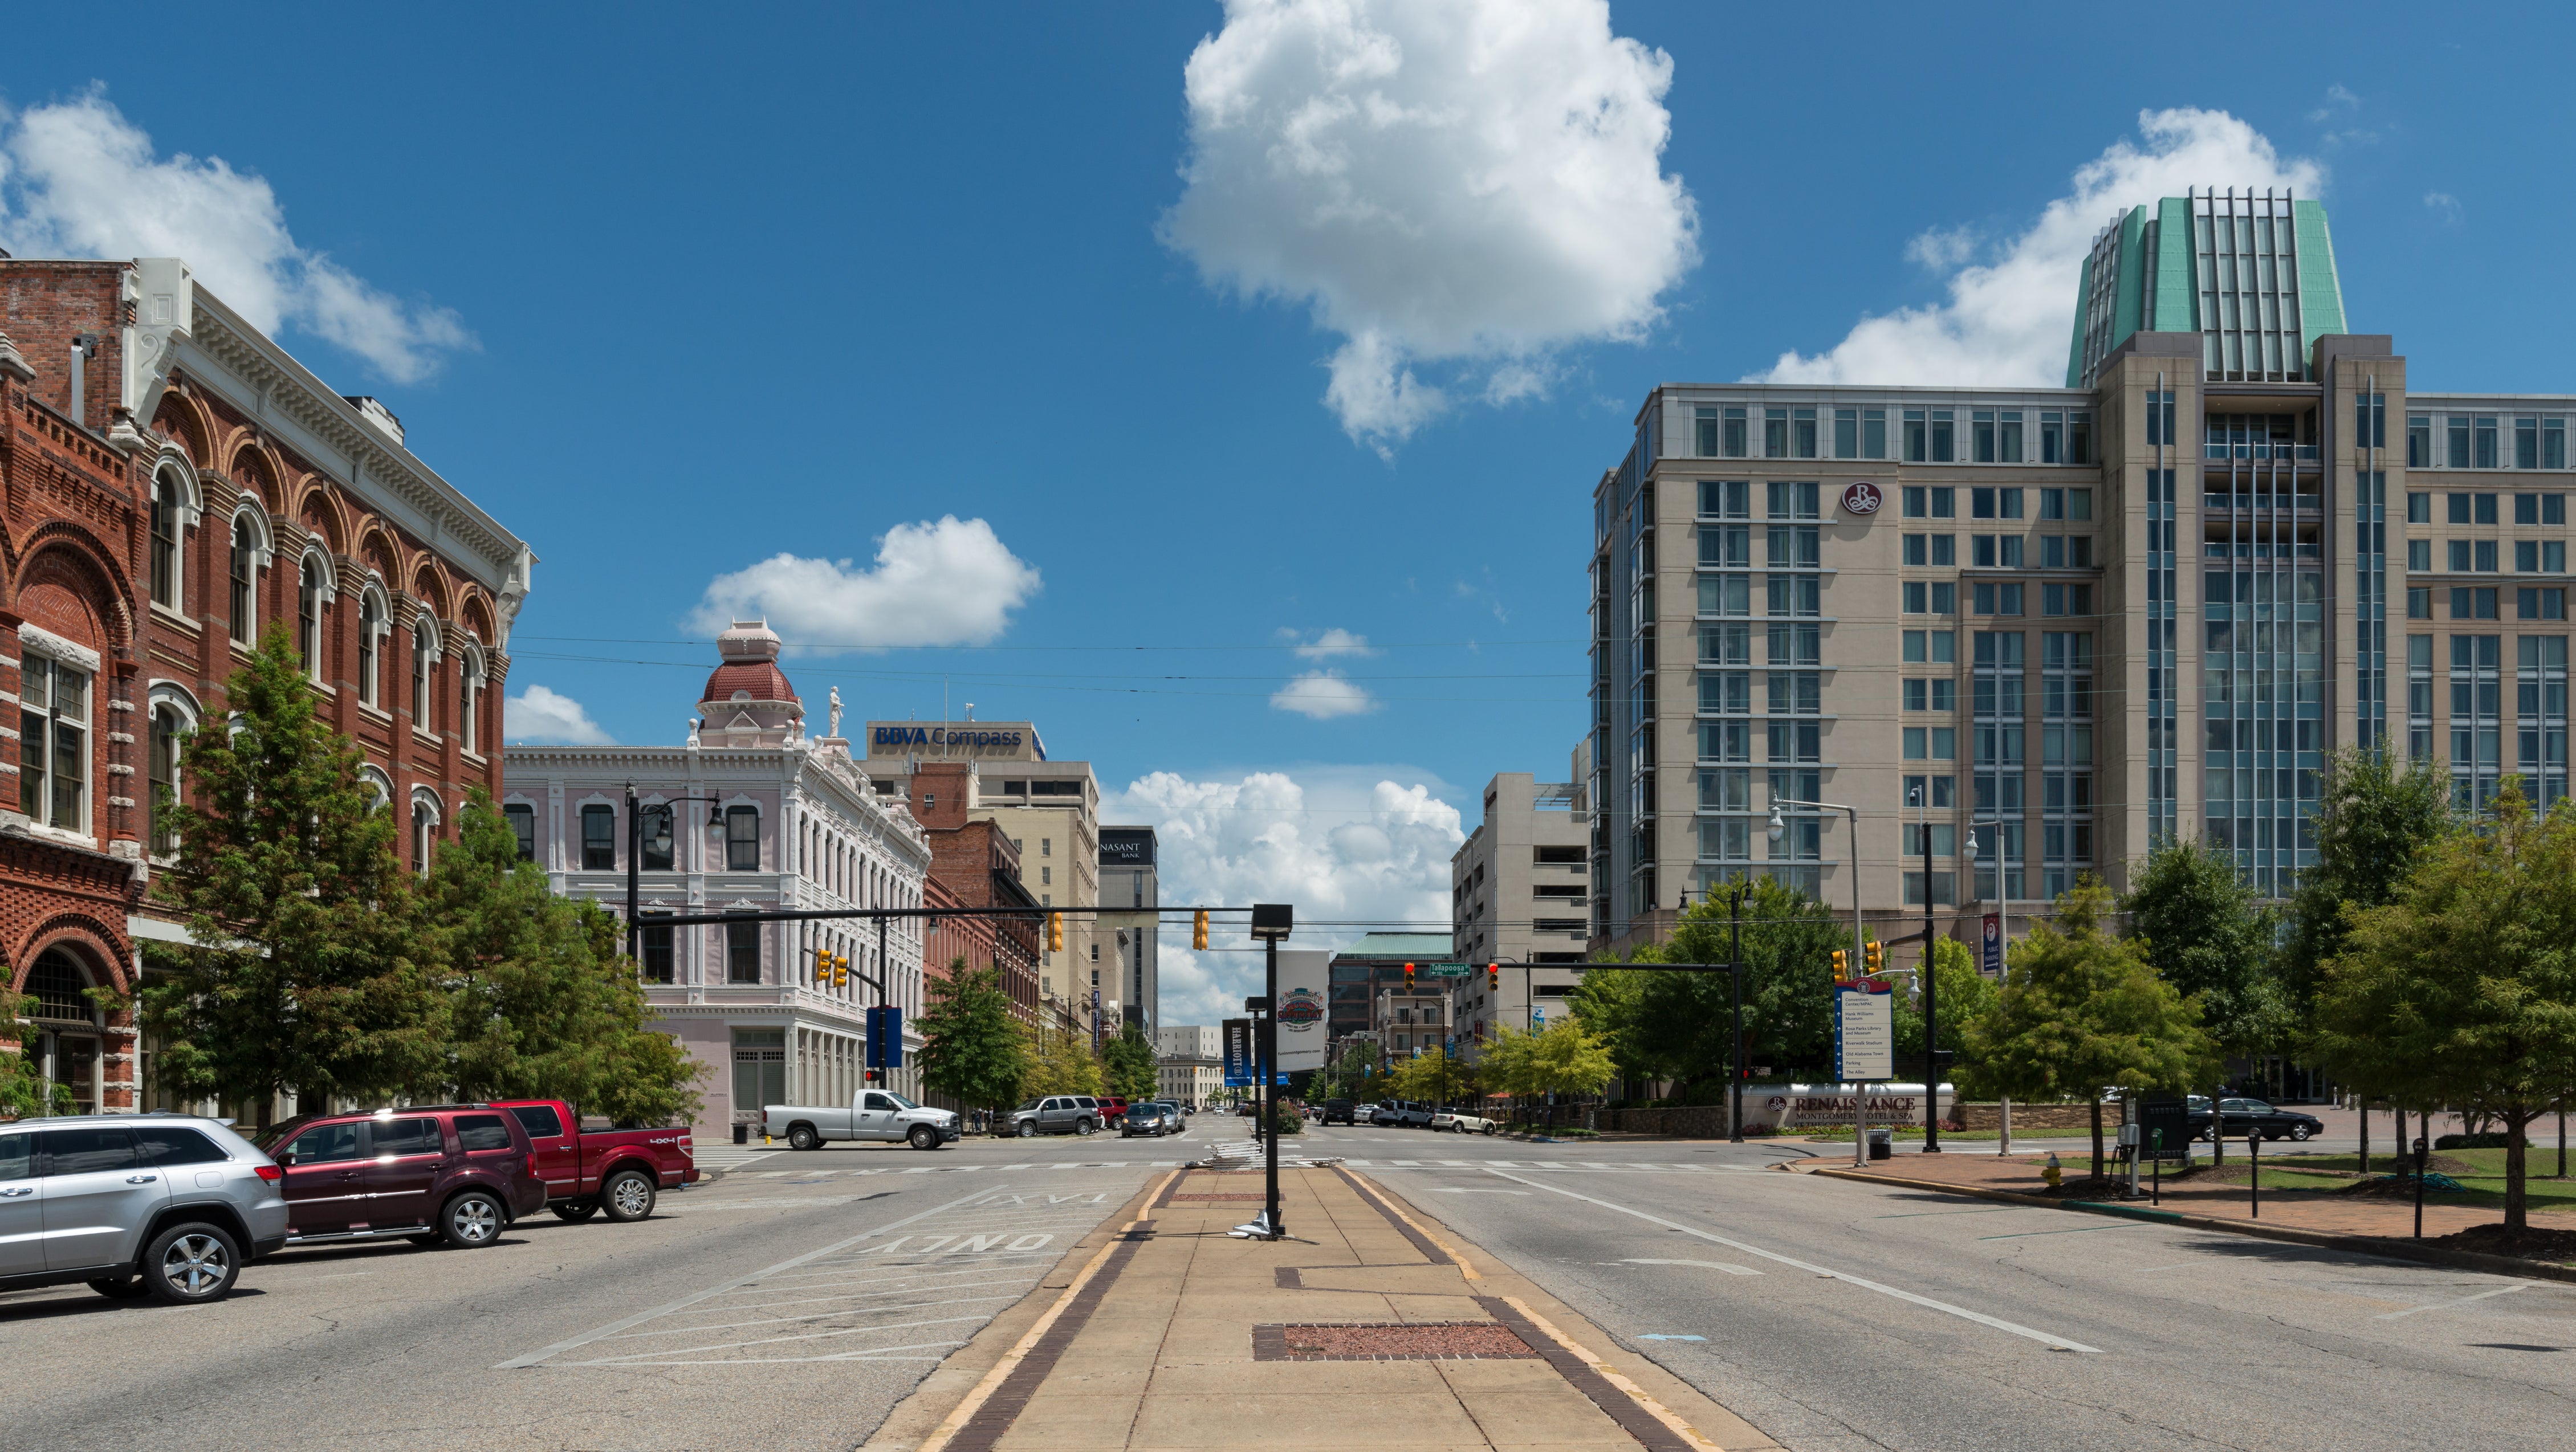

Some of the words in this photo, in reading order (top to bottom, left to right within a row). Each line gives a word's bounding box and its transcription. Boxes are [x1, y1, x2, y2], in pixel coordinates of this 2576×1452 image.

[876, 727, 928, 744] BBVA
[933, 728, 1022, 748] Compass
[1277, 1009, 1324, 1023] SATURDAY
[1286, 1002, 1316, 1010] SECOND
[1232, 1026, 1242, 1067] HARRIOTT
[855, 1233, 1055, 1254] ONLY
